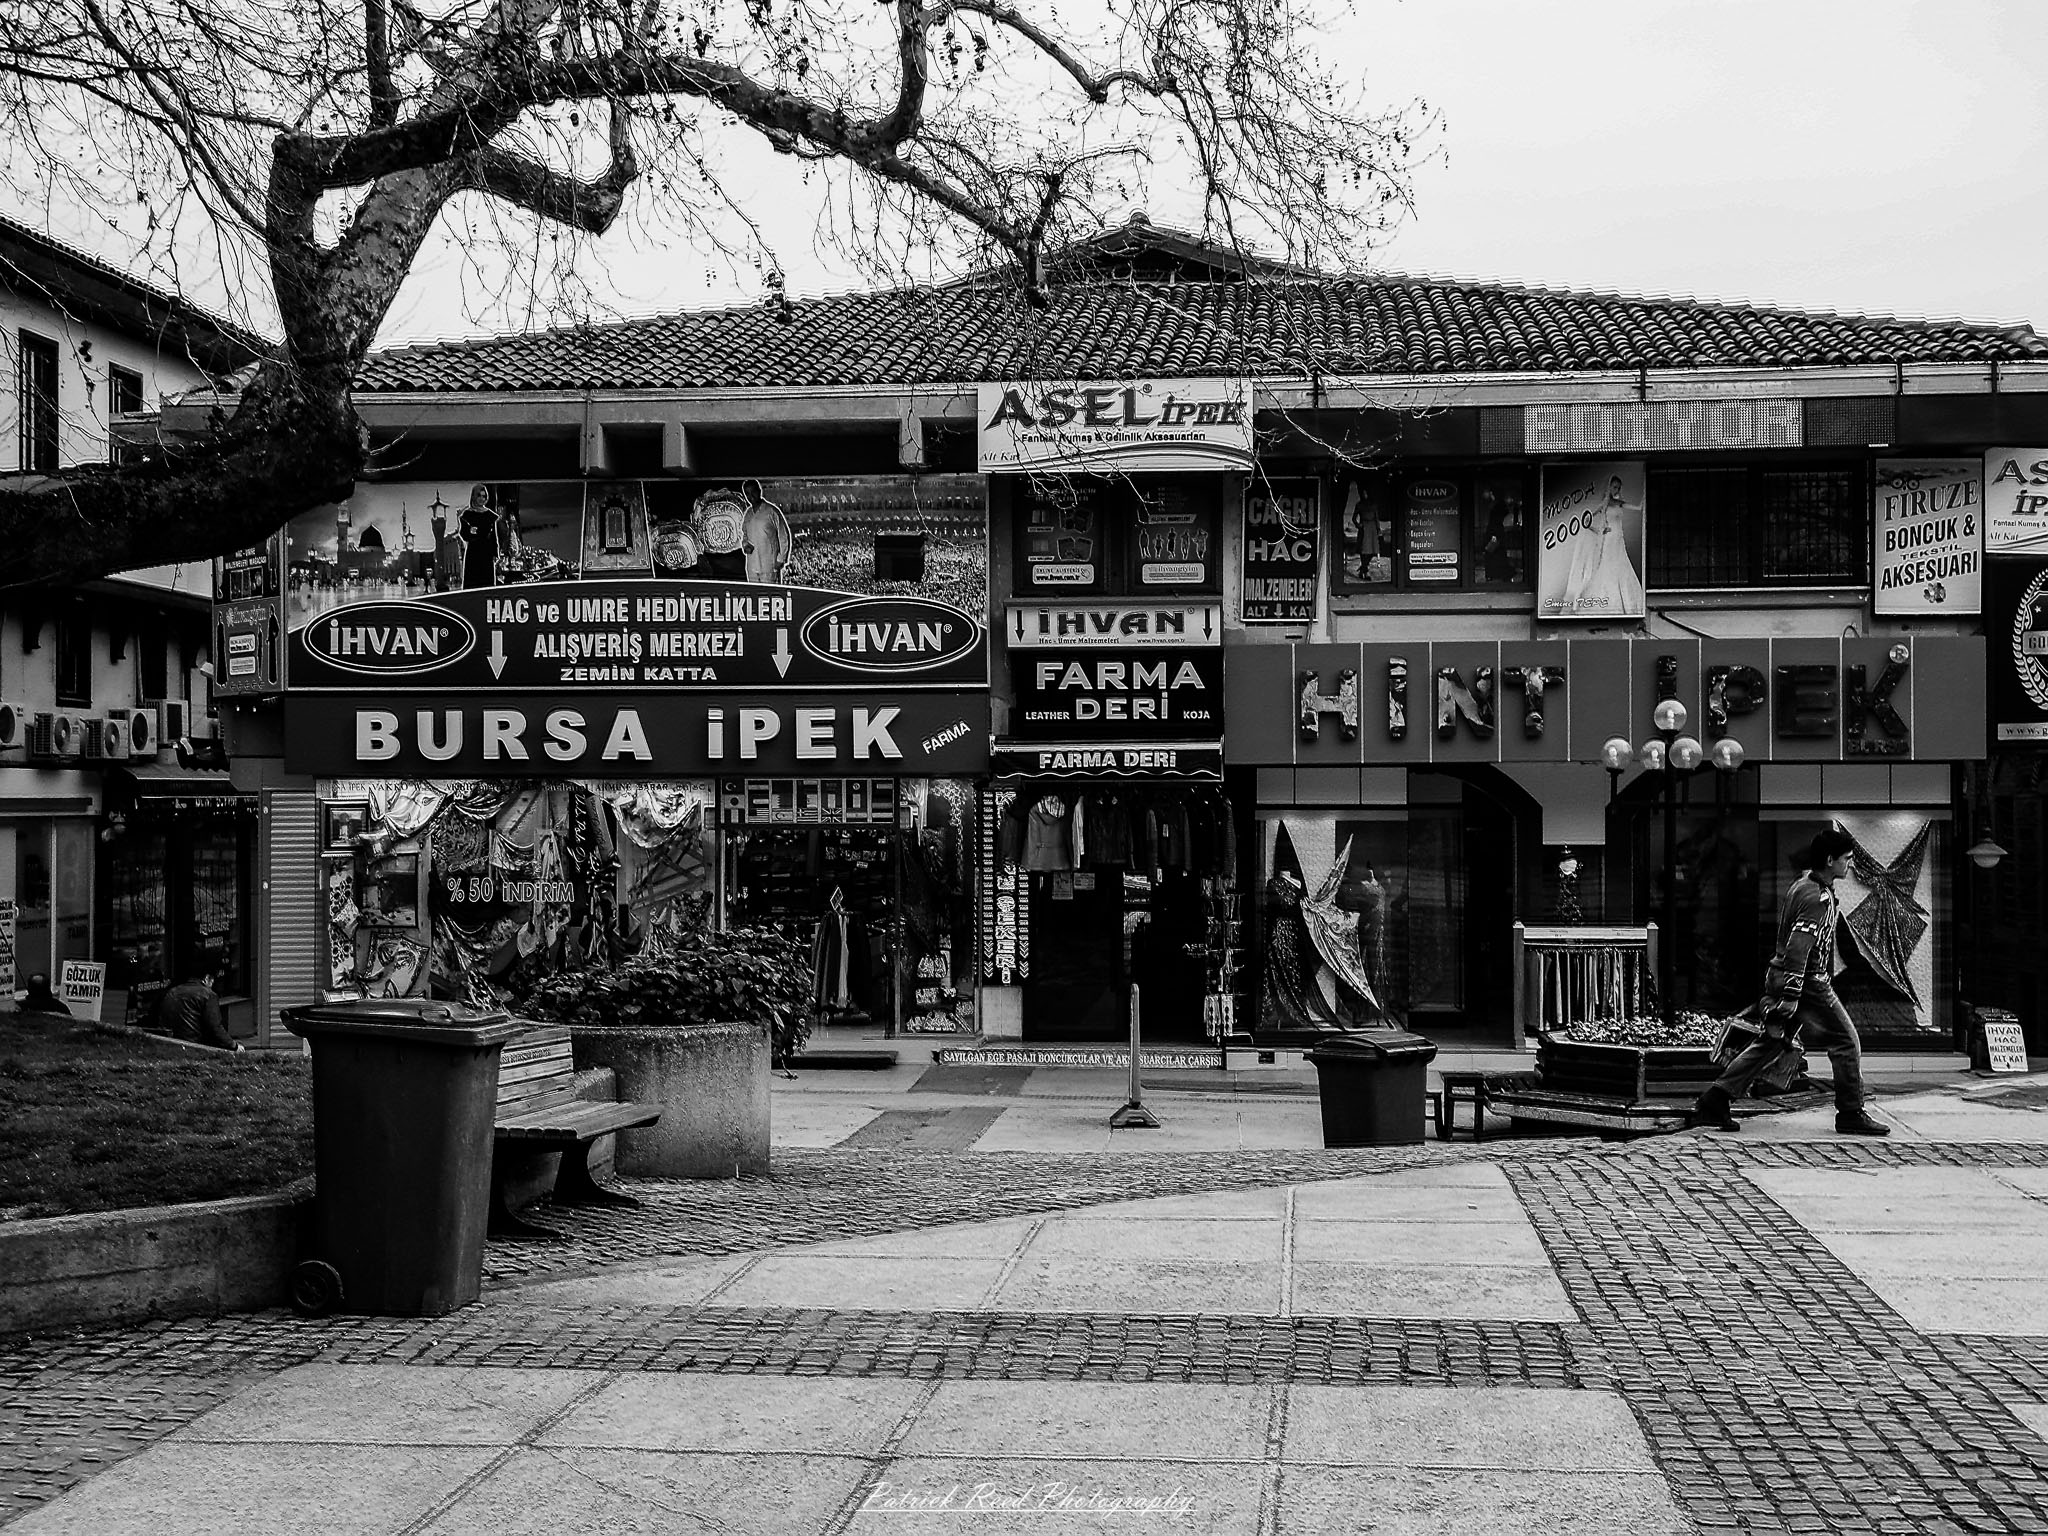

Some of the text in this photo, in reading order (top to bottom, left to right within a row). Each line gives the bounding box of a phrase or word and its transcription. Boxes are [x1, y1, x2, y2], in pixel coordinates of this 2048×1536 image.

[1543, 482, 1595, 519] MODA
[1544, 510, 1592, 550] 2000
[1885, 514, 1976, 553] BONCUK &
[1248, 539, 1312, 562] HAC
[1900, 543, 1962, 561] TEKSTİL
[1881, 551, 1978, 590] AKSESUARI
[1245, 573, 1315, 601] MALZEMELERİ
[487, 592, 793, 624] HAC ve UMRE HEDİYELİKLERİ
[1247, 605, 1269, 618] ALT
[534, 626, 744, 663] ALIŞVERİŞ MERKEZİ
[560, 662, 717, 681] ZEMİN KATTA
[1036, 661, 1205, 690] FARMA
[1025, 709, 1211, 721] LEATHER KOJA
[356, 708, 652, 761] BURSA
[922, 718, 971, 755] FARMA
[1039, 751, 1117, 769] FARMA
[447, 876, 465, 903] %
[469, 876, 494, 903] 50
[1994, 1036, 2018, 1044] HAC
[988, 1051, 1006, 1063] EGE
[1007, 1051, 1036, 1064] PASAJI
[1038, 1052, 1102, 1066] BONCUKÇULAR
[1103, 1053, 1114, 1065] VE
[1993, 1055, 2024, 1063] ALT KAT
